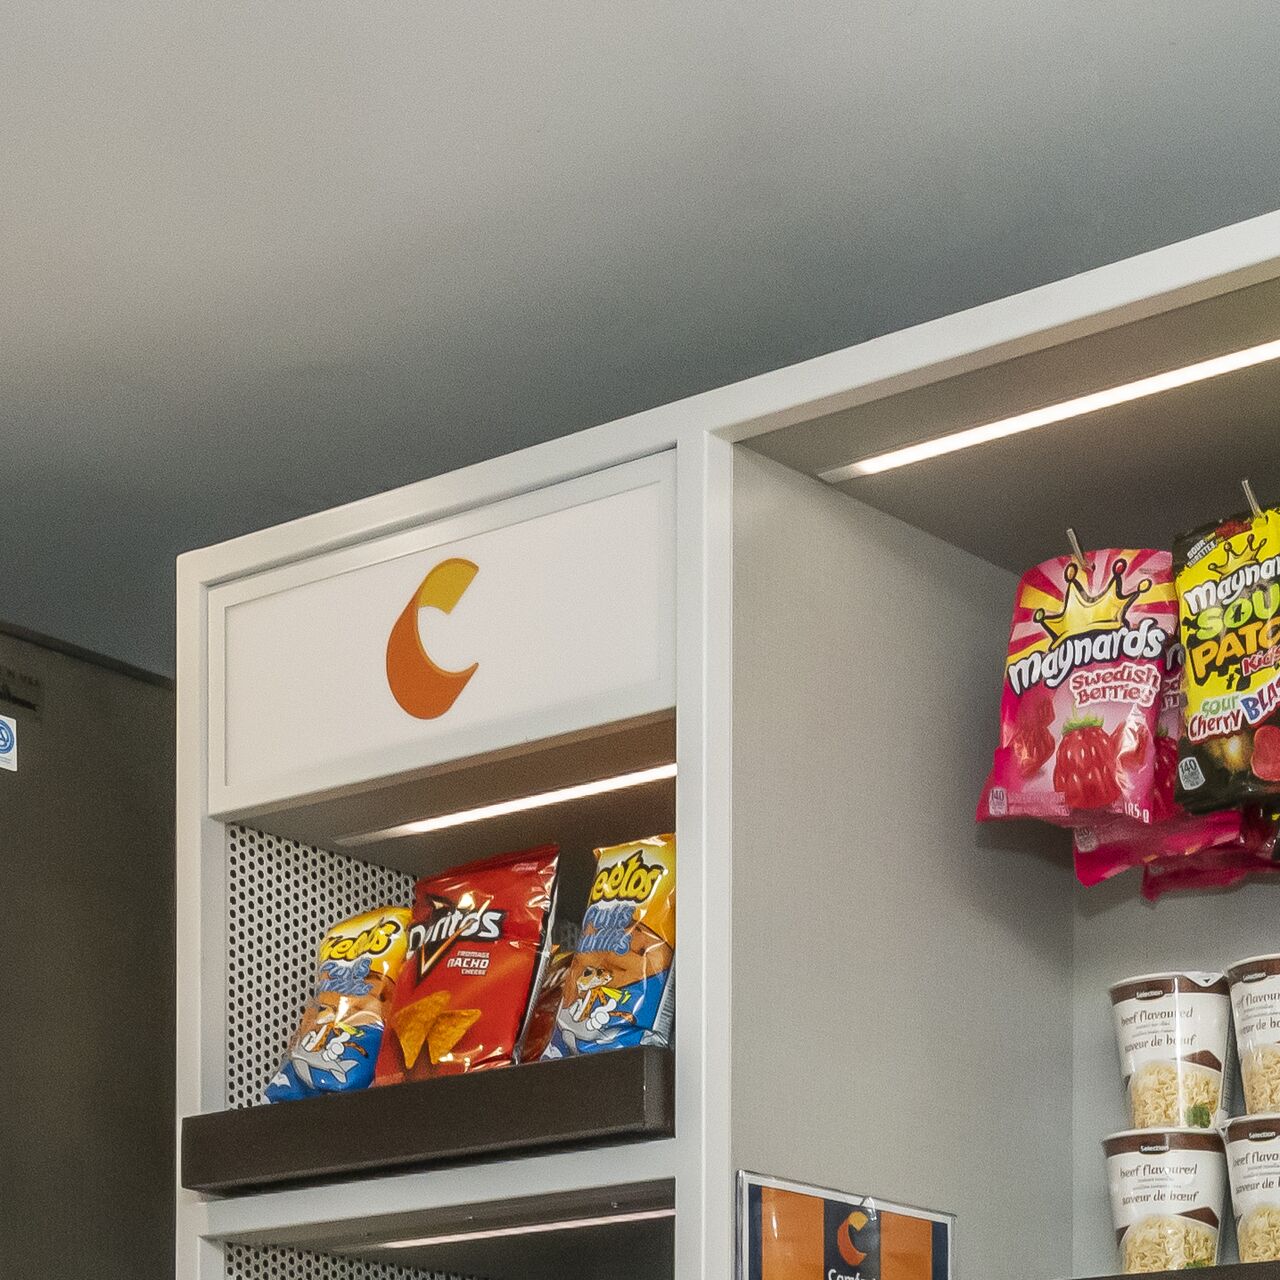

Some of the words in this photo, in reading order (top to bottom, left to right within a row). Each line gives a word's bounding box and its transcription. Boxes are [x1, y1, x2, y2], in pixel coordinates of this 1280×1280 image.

[1071, 662, 1160, 691] Swedish
[1076, 683, 1155, 708] Berries
[1189, 709, 1242, 738] Cherry
[1139, 1006, 1194, 1023] flavoued
